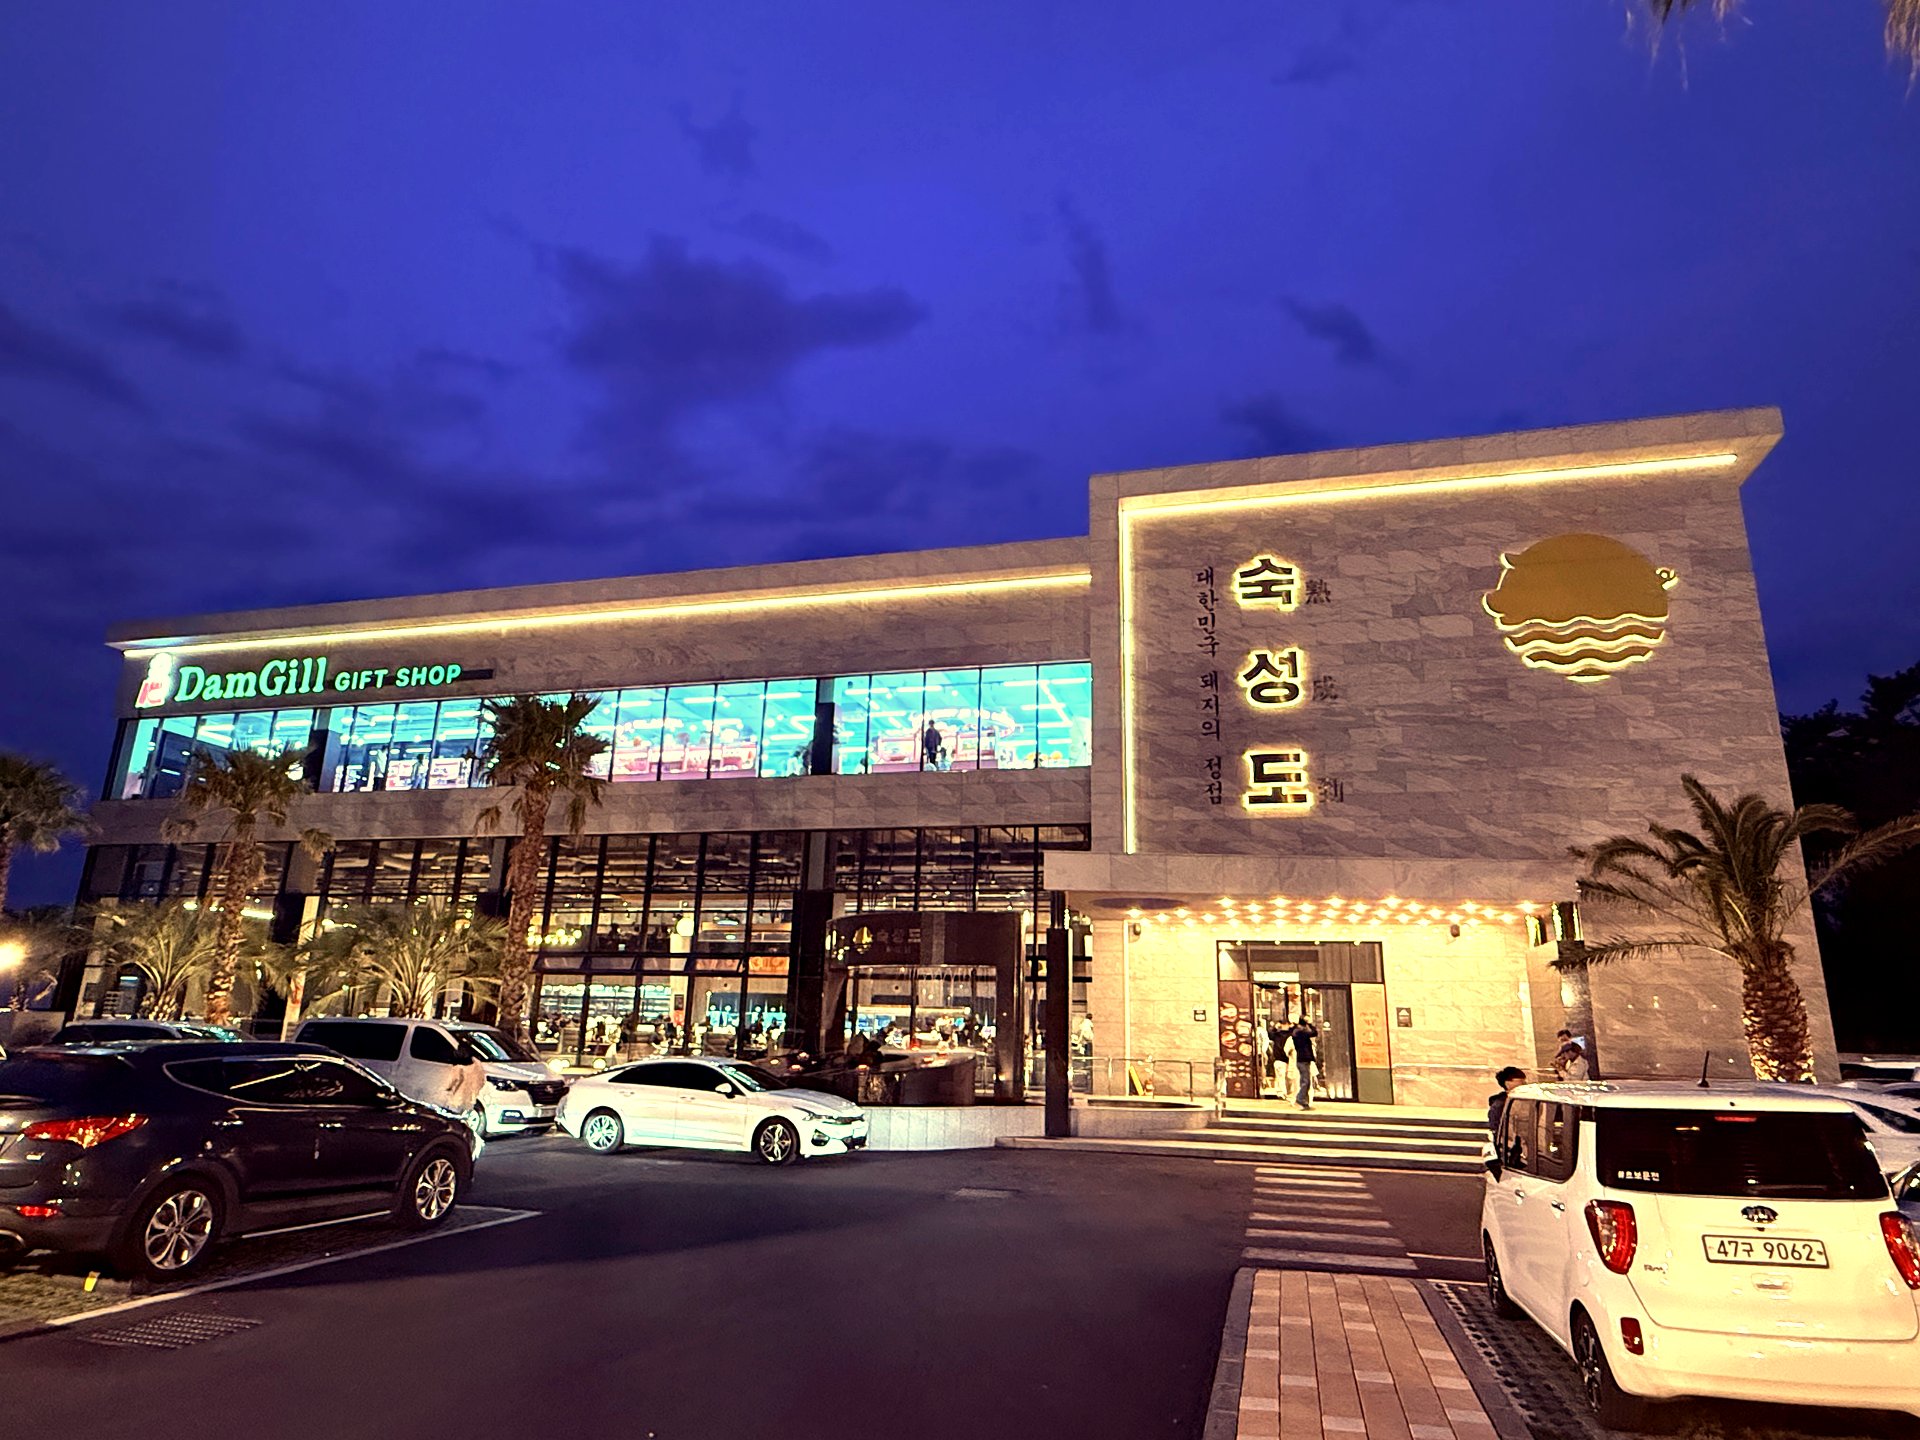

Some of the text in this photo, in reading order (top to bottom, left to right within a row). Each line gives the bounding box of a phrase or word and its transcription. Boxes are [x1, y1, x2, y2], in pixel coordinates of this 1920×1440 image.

[174, 656, 327, 702] DamGill
[334, 664, 462, 692] GIFT SHOP
[1196, 566, 1222, 805] 대한민국 돼지의 정점
[1238, 558, 1307, 804] 숙성도
[1717, 1240, 1816, 1262] 47구 9062
